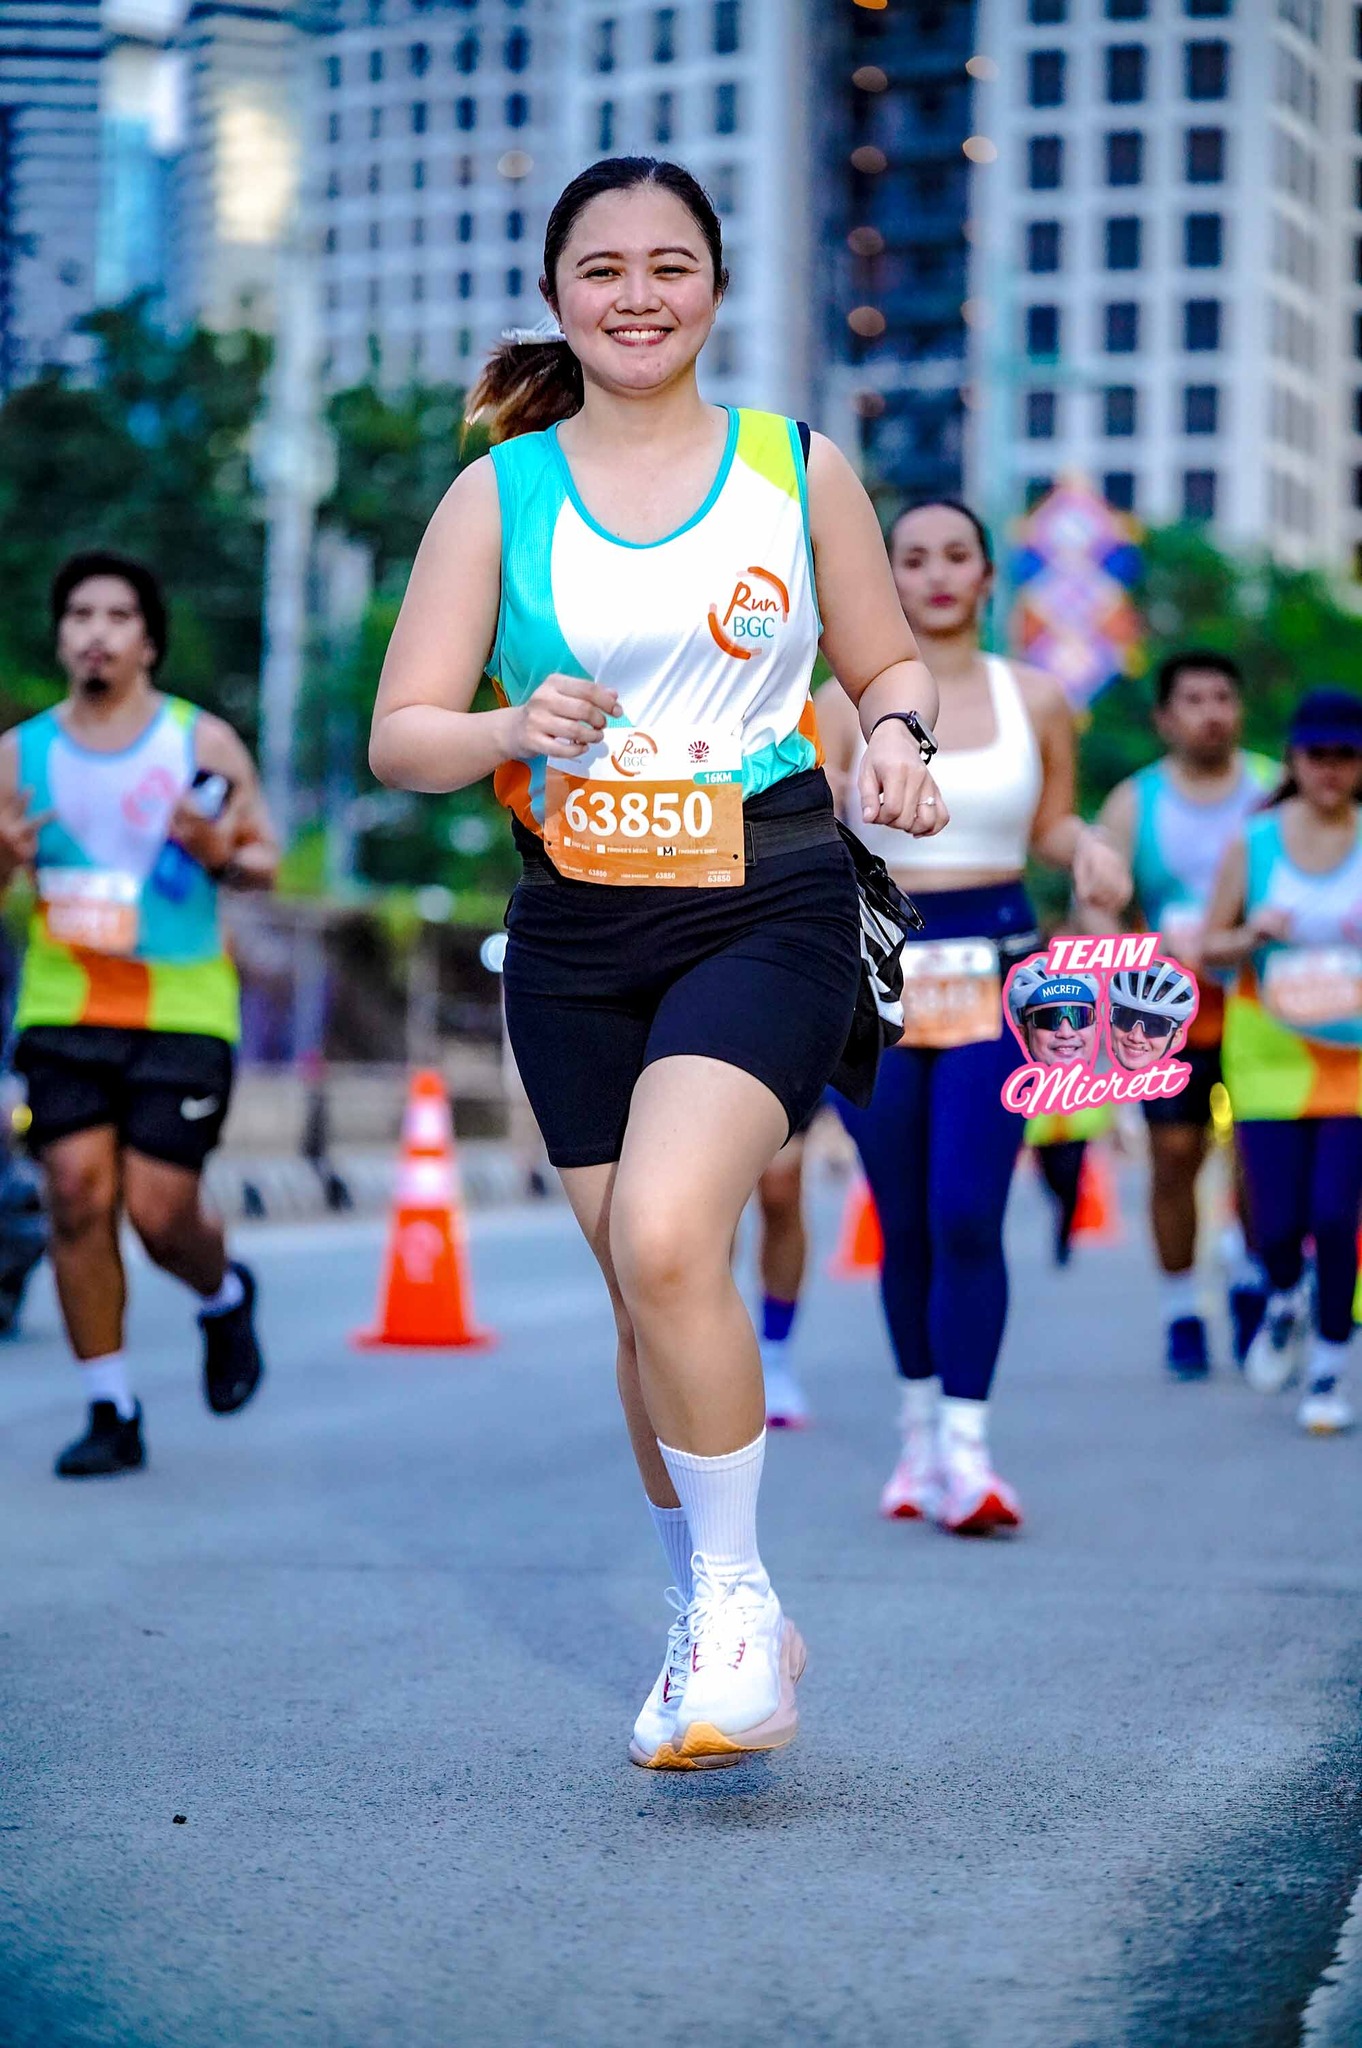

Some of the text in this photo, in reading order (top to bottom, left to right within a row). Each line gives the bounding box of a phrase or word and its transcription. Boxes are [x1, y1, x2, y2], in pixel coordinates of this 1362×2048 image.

[723, 581, 780, 626] Run
[733, 616, 775, 638] BGC
[617, 739, 650, 762] Run
[623, 756, 648, 767] BGC
[704, 772, 732, 784] 16KM
[564, 788, 713, 839] 63850
[663, 846, 674, 857] M
[588, 868, 608, 878] 63850
[655, 872, 676, 880] 63850
[707, 875, 731, 883] 63850
